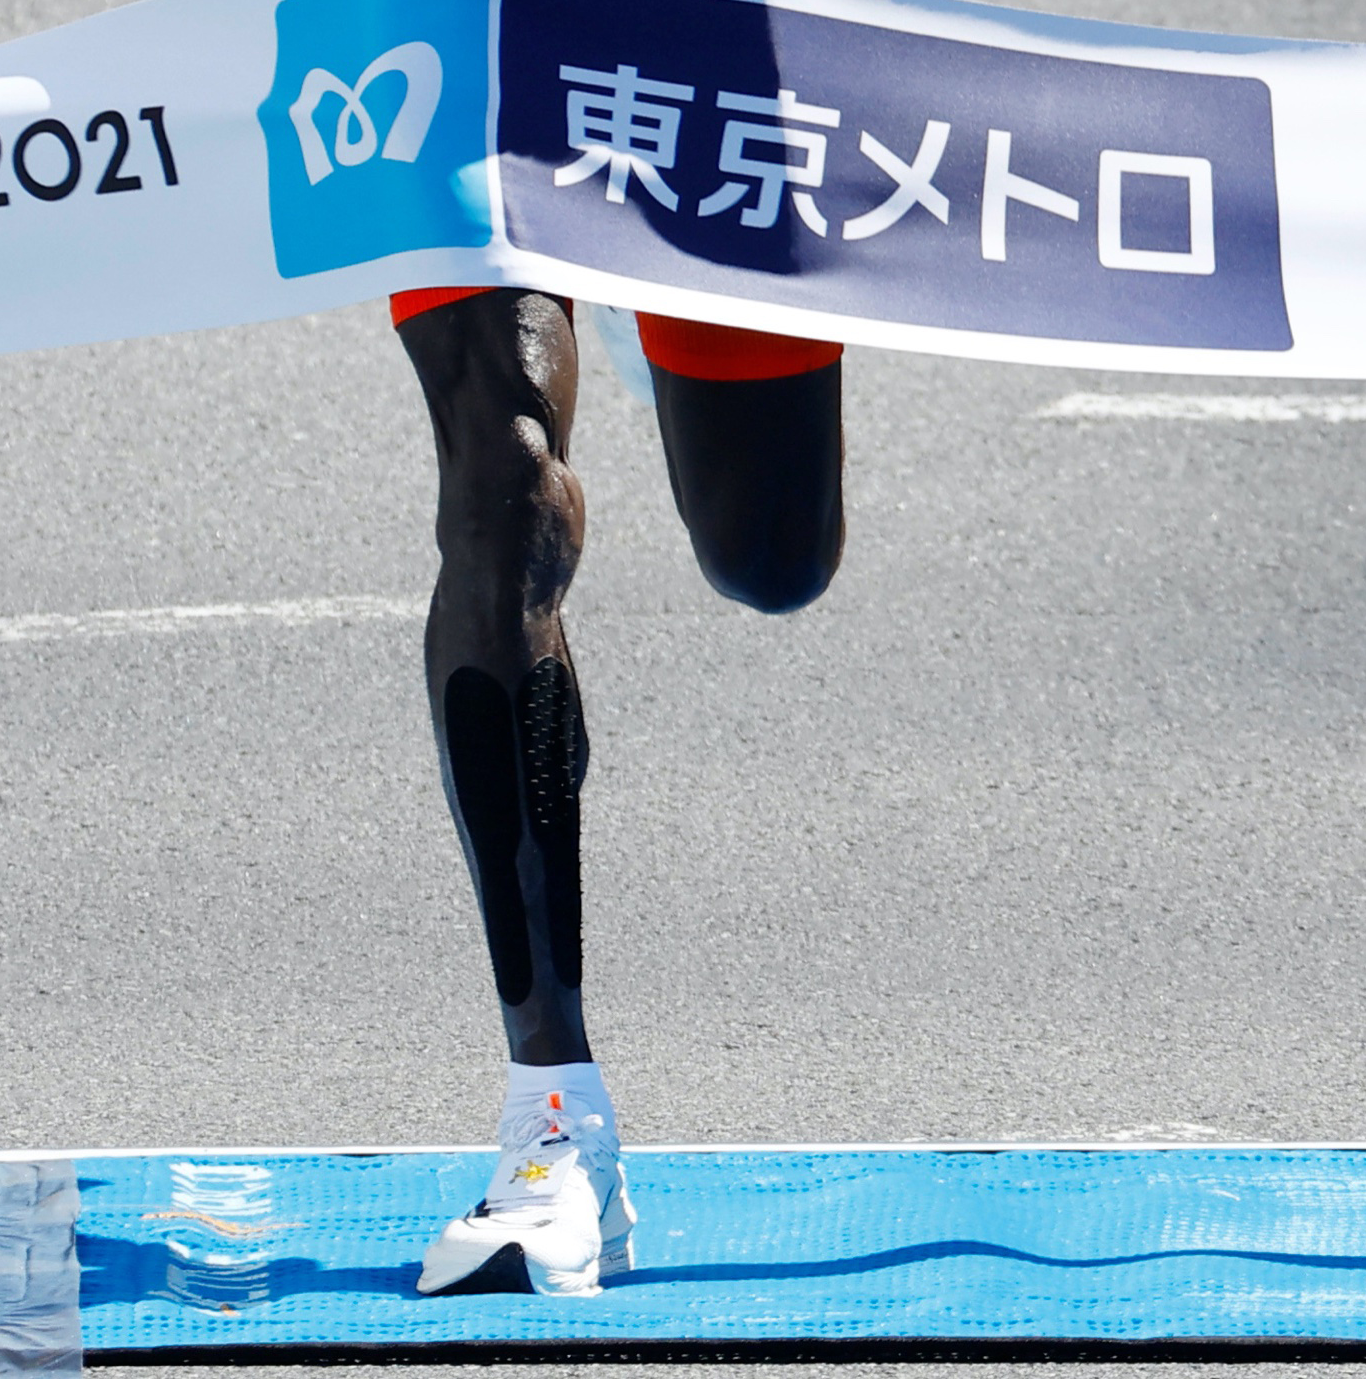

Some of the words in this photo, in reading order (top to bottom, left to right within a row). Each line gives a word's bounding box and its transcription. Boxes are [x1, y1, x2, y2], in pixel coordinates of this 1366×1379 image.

[553, 64, 1217, 276] 東京メトロ
